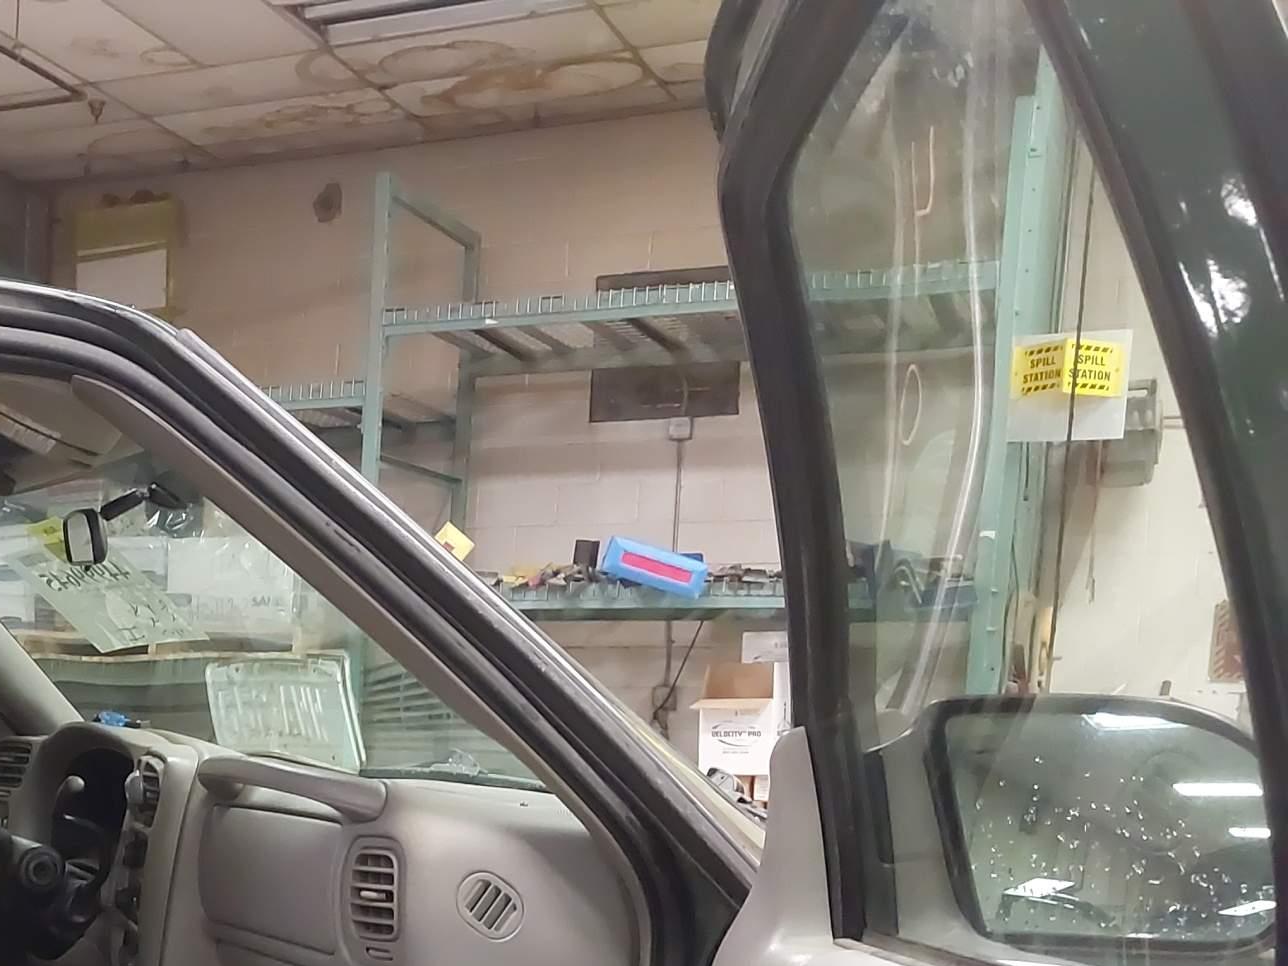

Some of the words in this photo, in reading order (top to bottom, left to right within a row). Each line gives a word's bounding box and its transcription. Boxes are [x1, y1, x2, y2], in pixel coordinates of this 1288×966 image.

[1030, 356, 1056, 368] SPILL
[1078, 354, 1106, 366] SPILL
[1023, 369, 1061, 384] STATION
[1069, 368, 1110, 381] STATION
